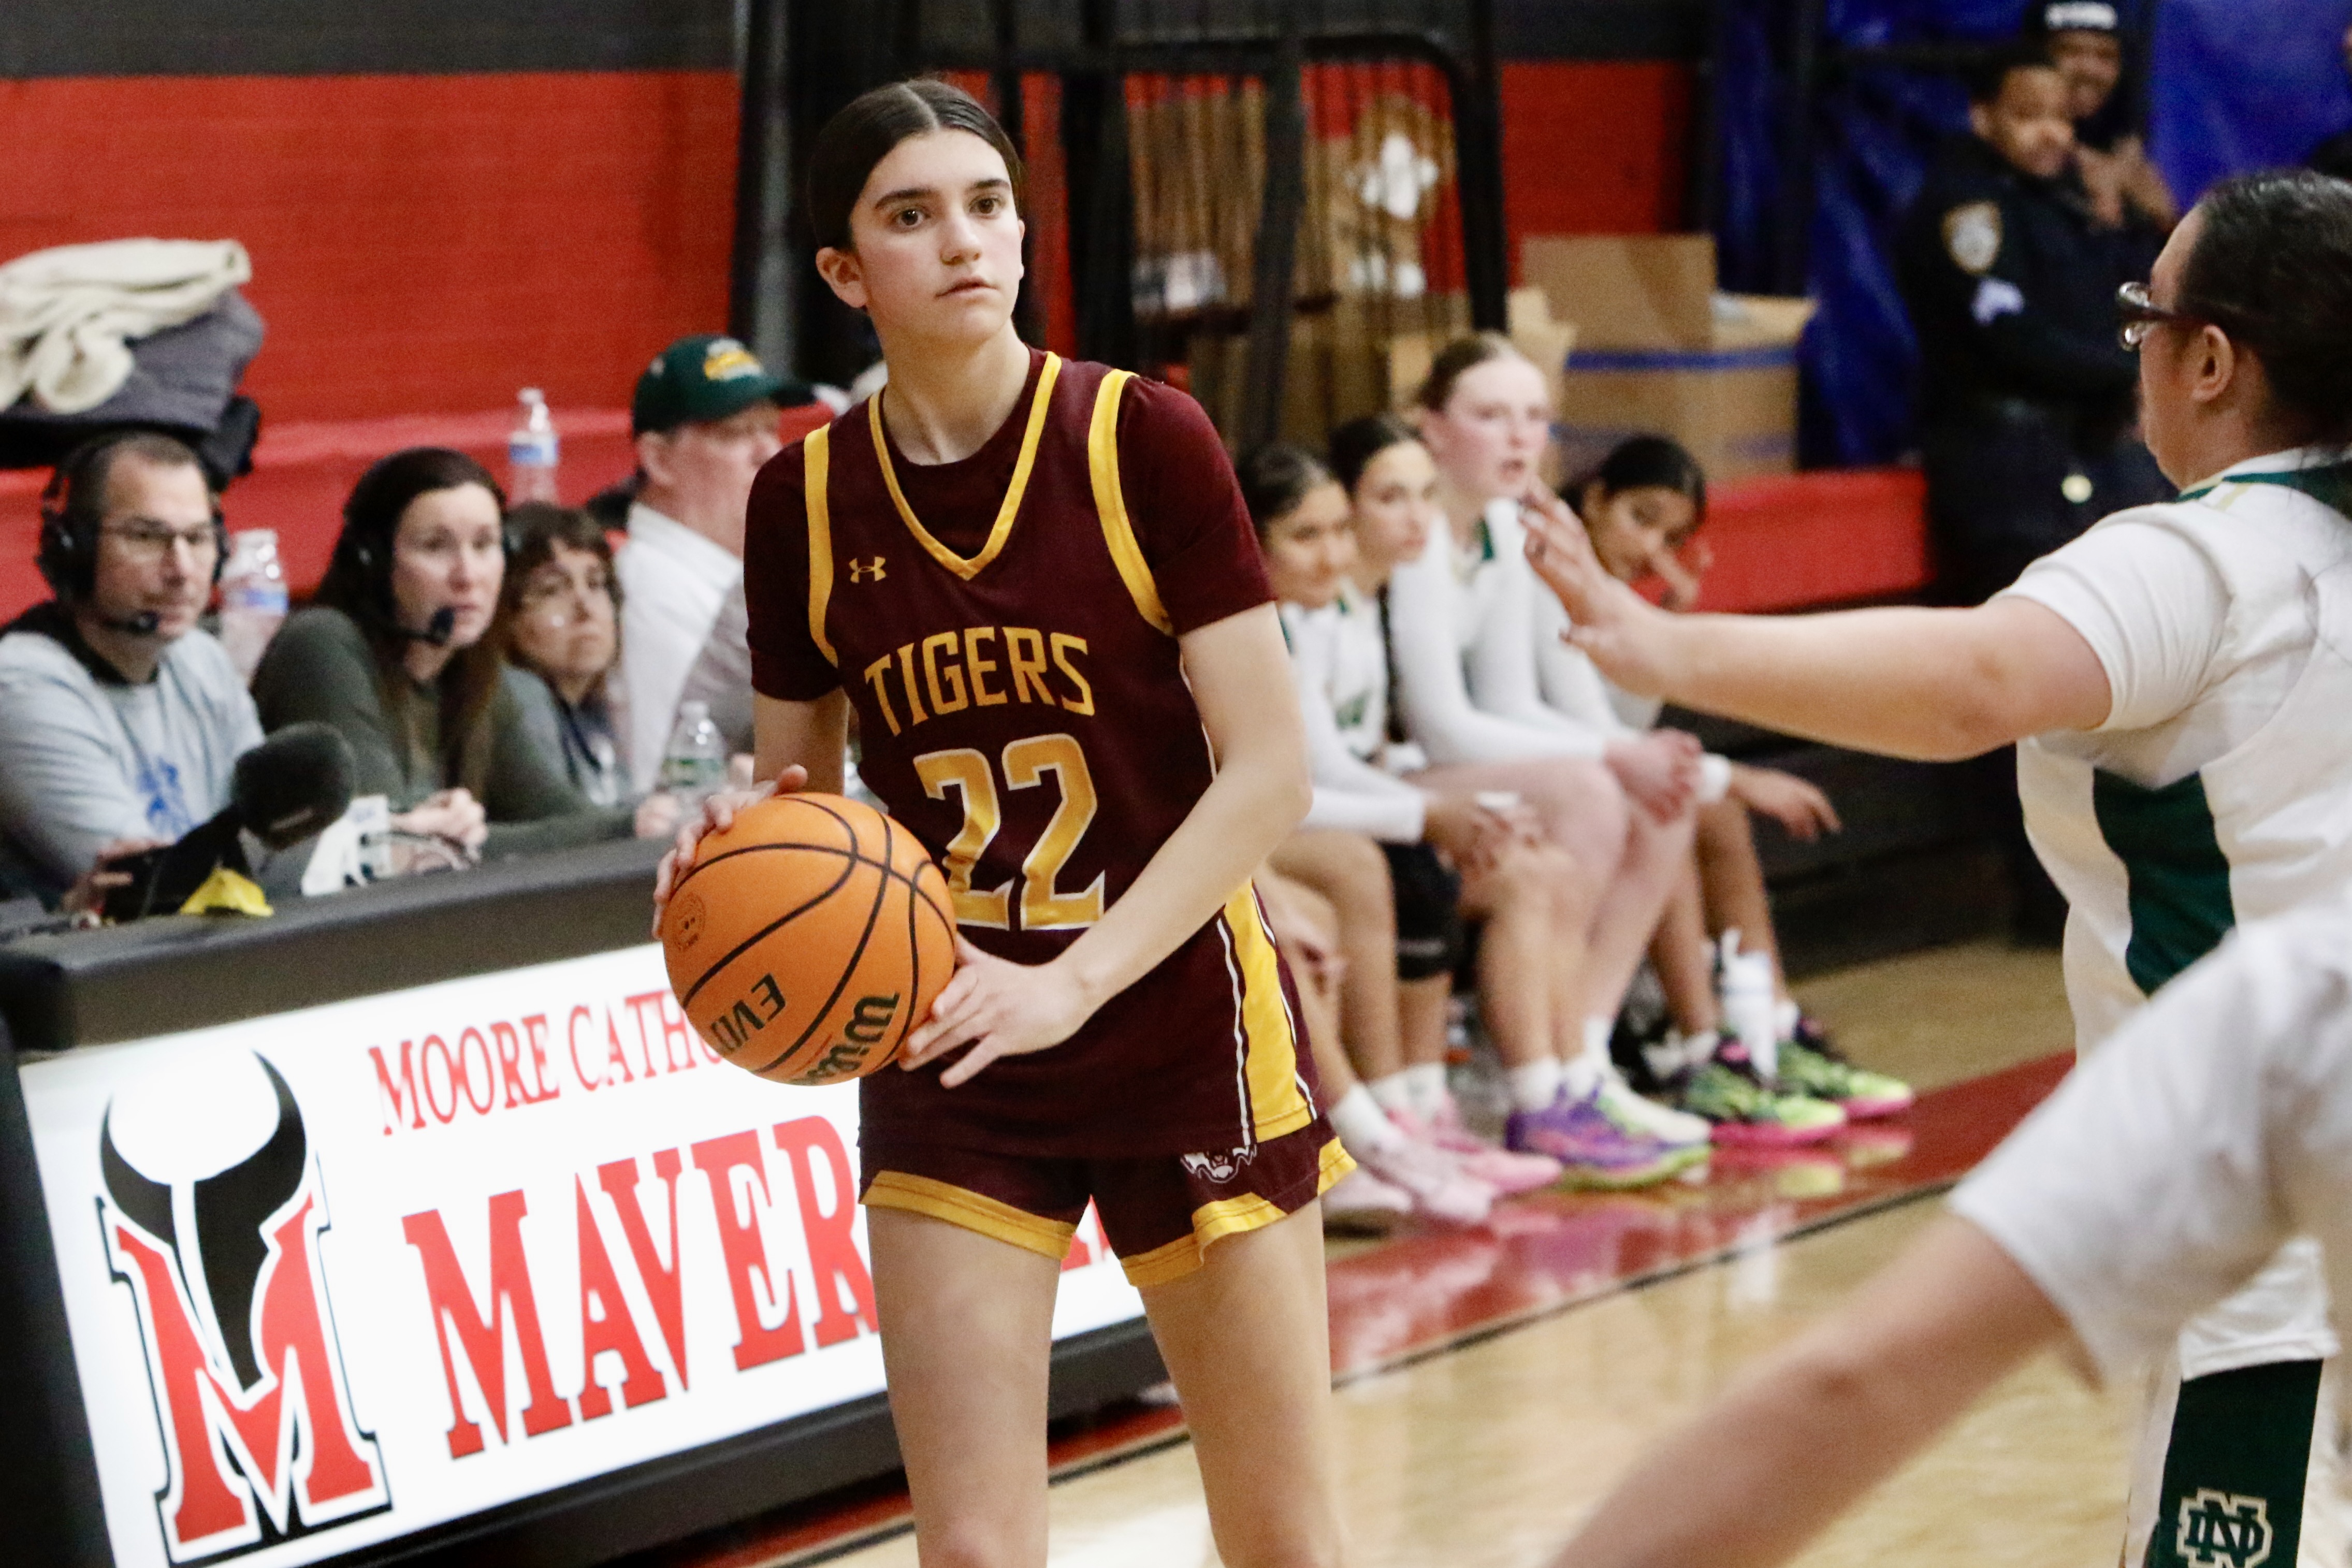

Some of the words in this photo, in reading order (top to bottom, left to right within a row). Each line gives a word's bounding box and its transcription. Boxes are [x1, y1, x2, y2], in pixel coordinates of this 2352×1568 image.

[864, 626, 1095, 737] TIGERS
[913, 733, 1106, 931] 22
[710, 972, 786, 1053] EVO
[367, 1013, 561, 1137] MOORE
